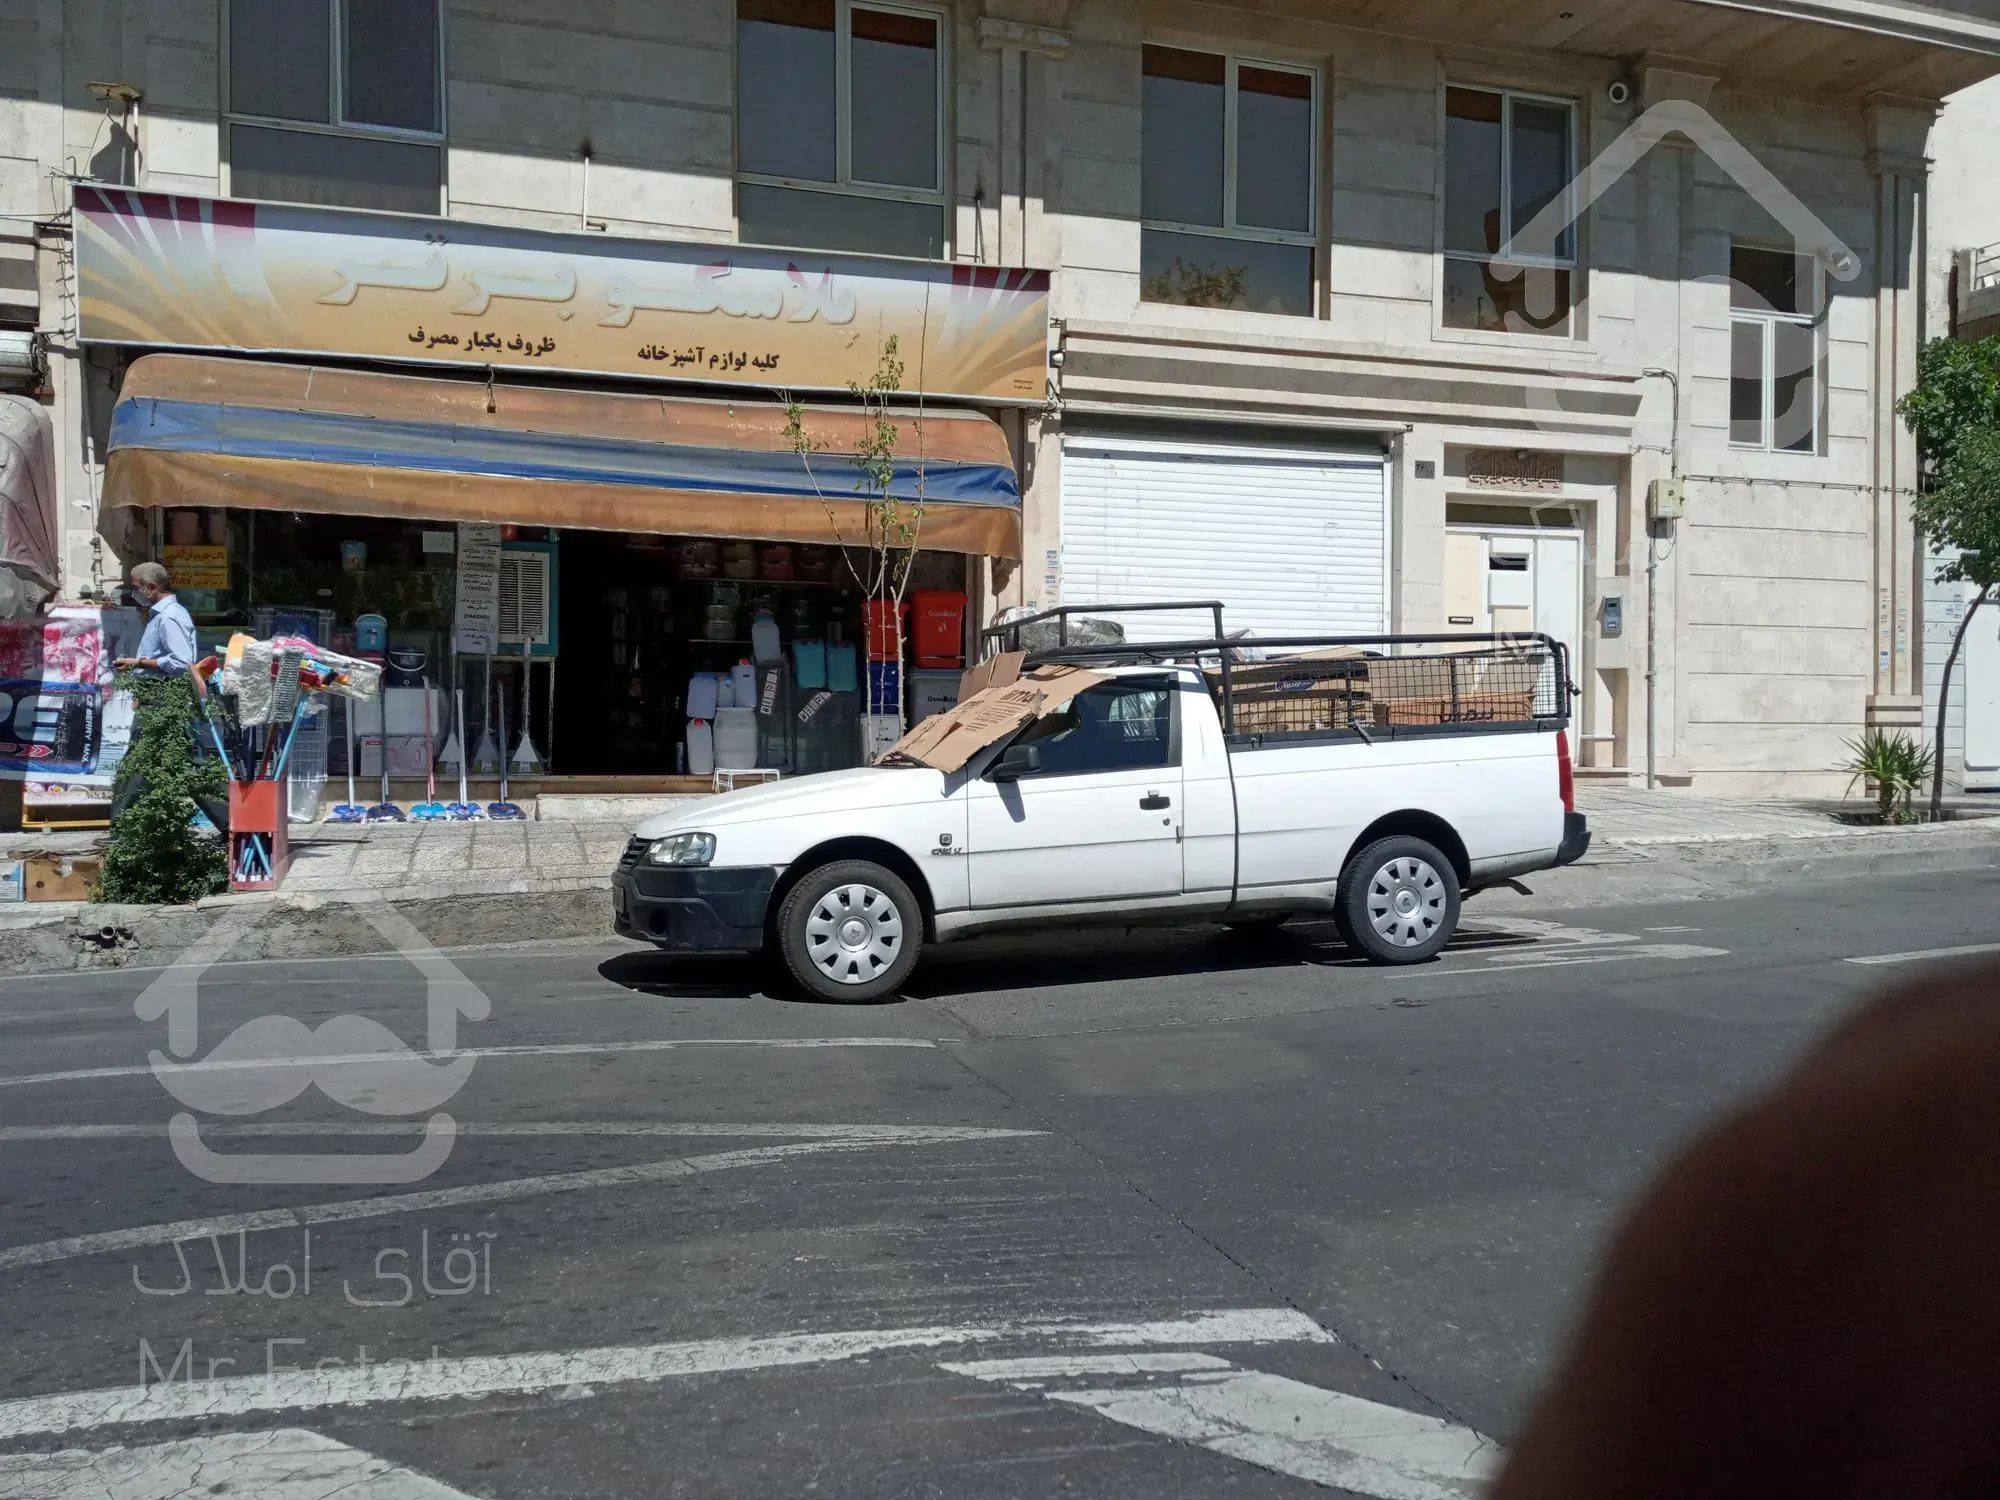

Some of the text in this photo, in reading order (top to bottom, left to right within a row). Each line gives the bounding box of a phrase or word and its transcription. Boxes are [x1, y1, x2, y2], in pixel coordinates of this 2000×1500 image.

[408, 325, 556, 357] ظروف یکبار مصرف
[637, 344, 780, 372] کلیه لوازم آشپزخانه
[85, 709, 94, 742] BERRY
[82, 743, 92, 763] MAX
